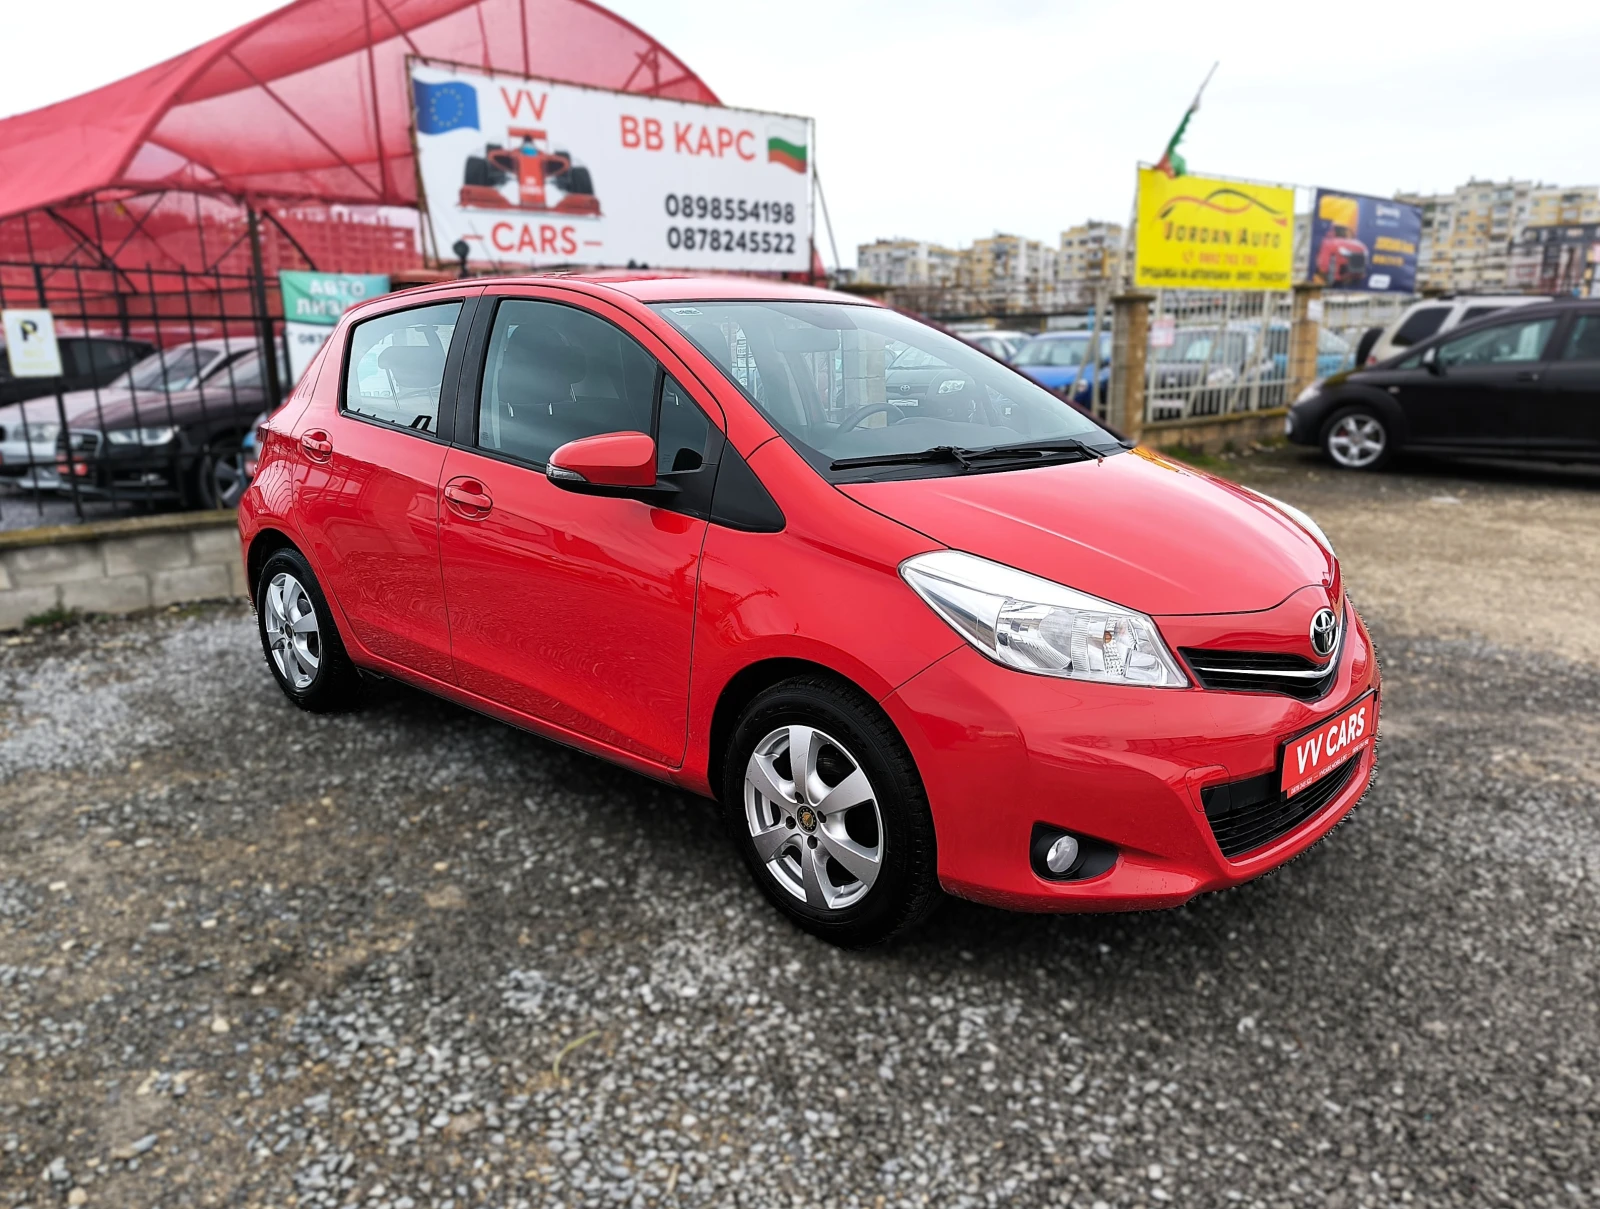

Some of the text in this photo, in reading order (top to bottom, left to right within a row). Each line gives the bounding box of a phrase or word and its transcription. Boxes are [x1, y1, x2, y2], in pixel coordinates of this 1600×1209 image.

[500, 87, 548, 121] VV
[674, 122, 756, 161] КАРС
[665, 194, 795, 224] 0898554198
[491, 222, 578, 254] CARS
[667, 227, 795, 254] 0878245522
[309, 279, 366, 297] АВТО
[1296, 706, 1366, 775] VV CARS
